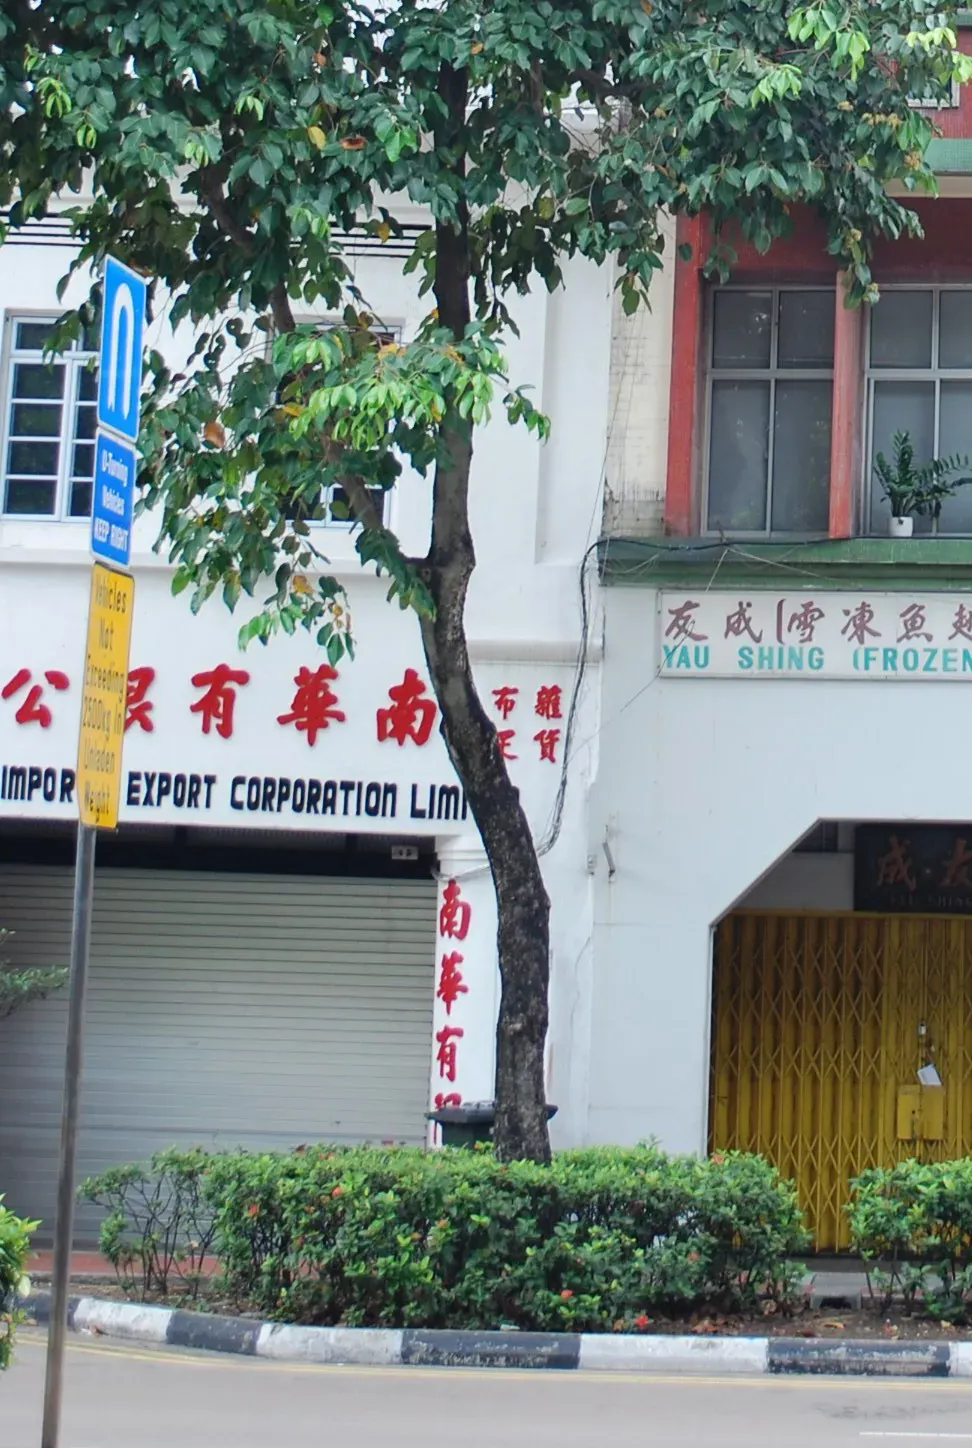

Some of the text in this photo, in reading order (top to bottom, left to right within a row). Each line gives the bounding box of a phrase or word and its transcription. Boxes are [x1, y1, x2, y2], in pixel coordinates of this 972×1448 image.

[101, 485, 125, 516] Vehicles
[94, 518, 129, 552] KEEP RIGHT
[94, 573, 126, 614] Vehicles
[98, 618, 113, 651] Not
[661, 644, 711, 670] YAU
[737, 645, 825, 671] SHING
[84, 655, 125, 704] Exceeding
[82, 697, 112, 741] 2500kg
[83, 737, 115, 774] Unladen
[1, 765, 467, 820] IMPOR EXPORT CORPORATION LIMI
[83, 780, 111, 823] Weight
